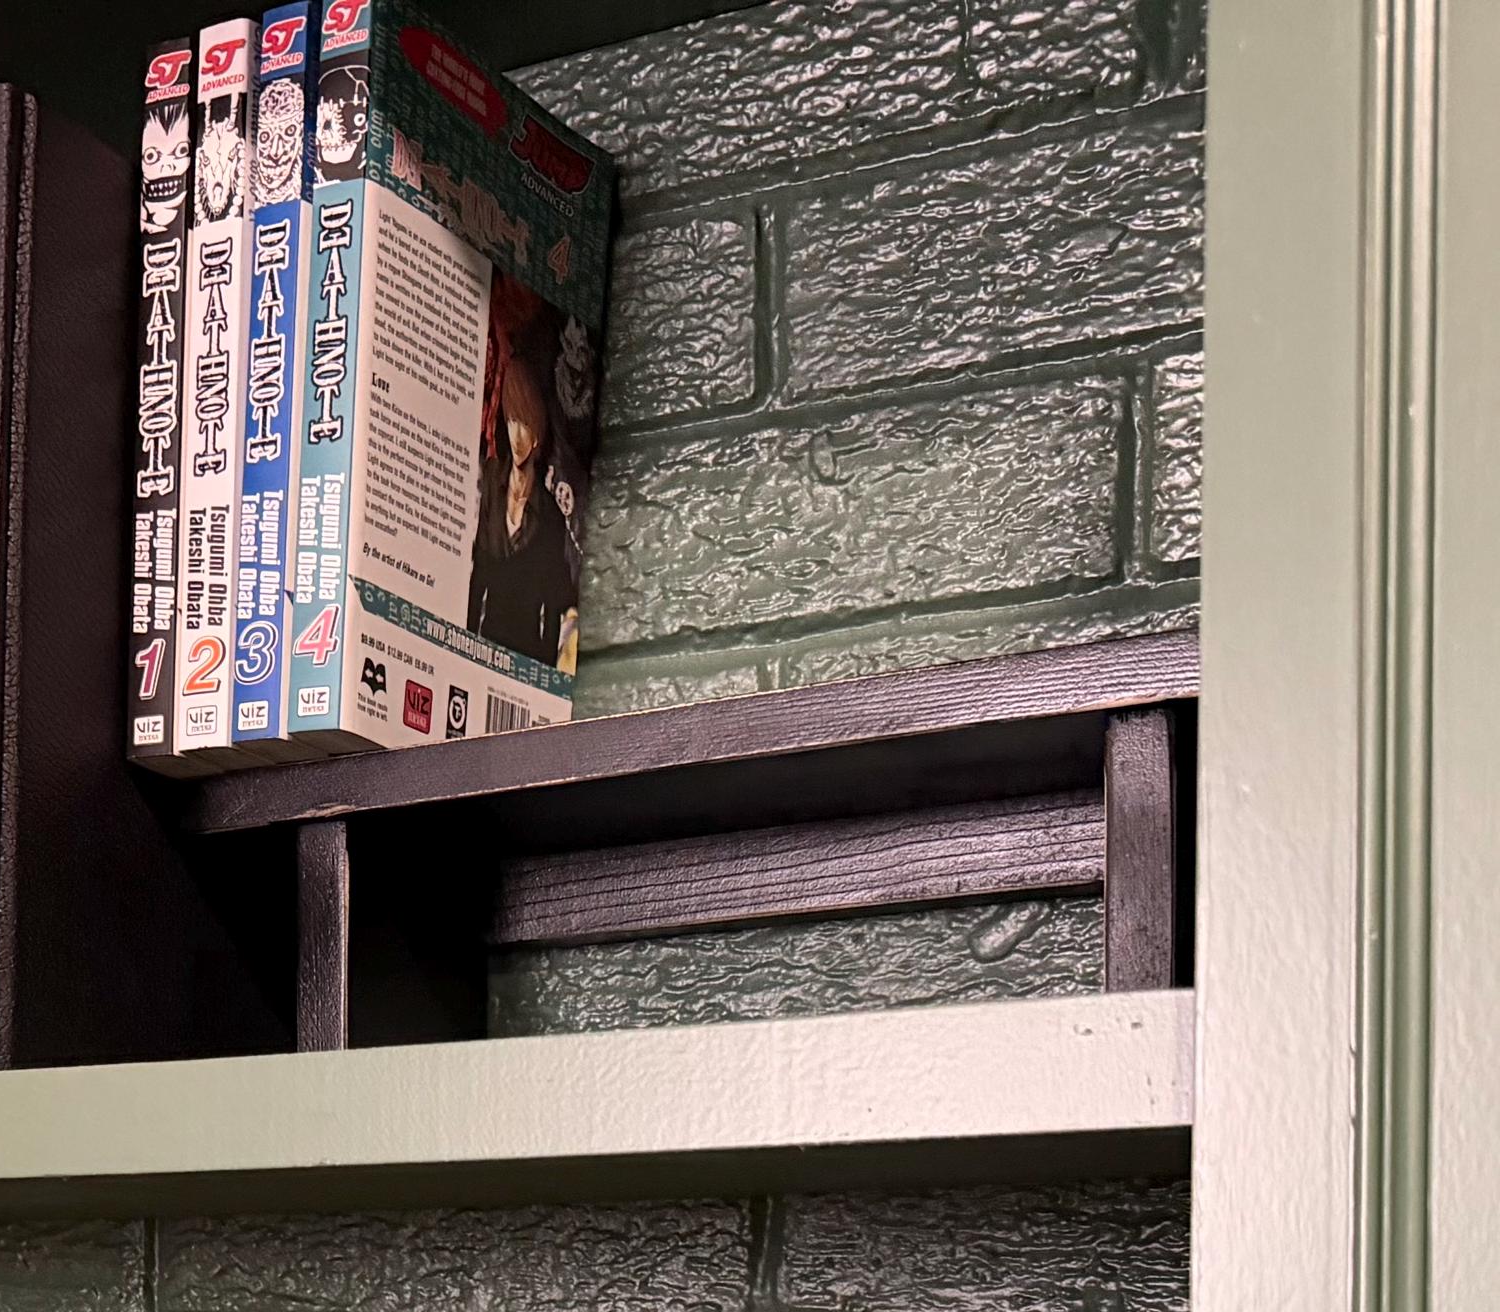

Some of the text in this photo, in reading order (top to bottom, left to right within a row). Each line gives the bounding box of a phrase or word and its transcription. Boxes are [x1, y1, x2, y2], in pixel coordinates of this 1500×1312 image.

[261, 52, 304, 74] ADVANCED
[324, 30, 368, 49] ADVANCED
[147, 83, 190, 102] ADVANCED
[202, 74, 244, 93] ADVANCED
[520, 172, 575, 218] ADVANCED
[550, 234, 573, 285] 4
[372, 372, 390, 394] Love
[207, 505, 230, 627] Tsugumi Ohba
[236, 493, 260, 620] Takeshi Obata
[259, 489, 284, 616] Tsugumi Ohba
[295, 475, 321, 604] Takeshi Obata
[318, 472, 345, 601] Tsugumi Ohba
[132, 510, 154, 633] Takeshi Obata
[153, 508, 177, 631] Tsugumi Ohba
[186, 508, 206, 630] Takeshi Obata
[182, 635, 227, 696] 2
[234, 620, 279, 686] 3
[294, 603, 341, 667] 4
[134, 638, 166, 701] 1
